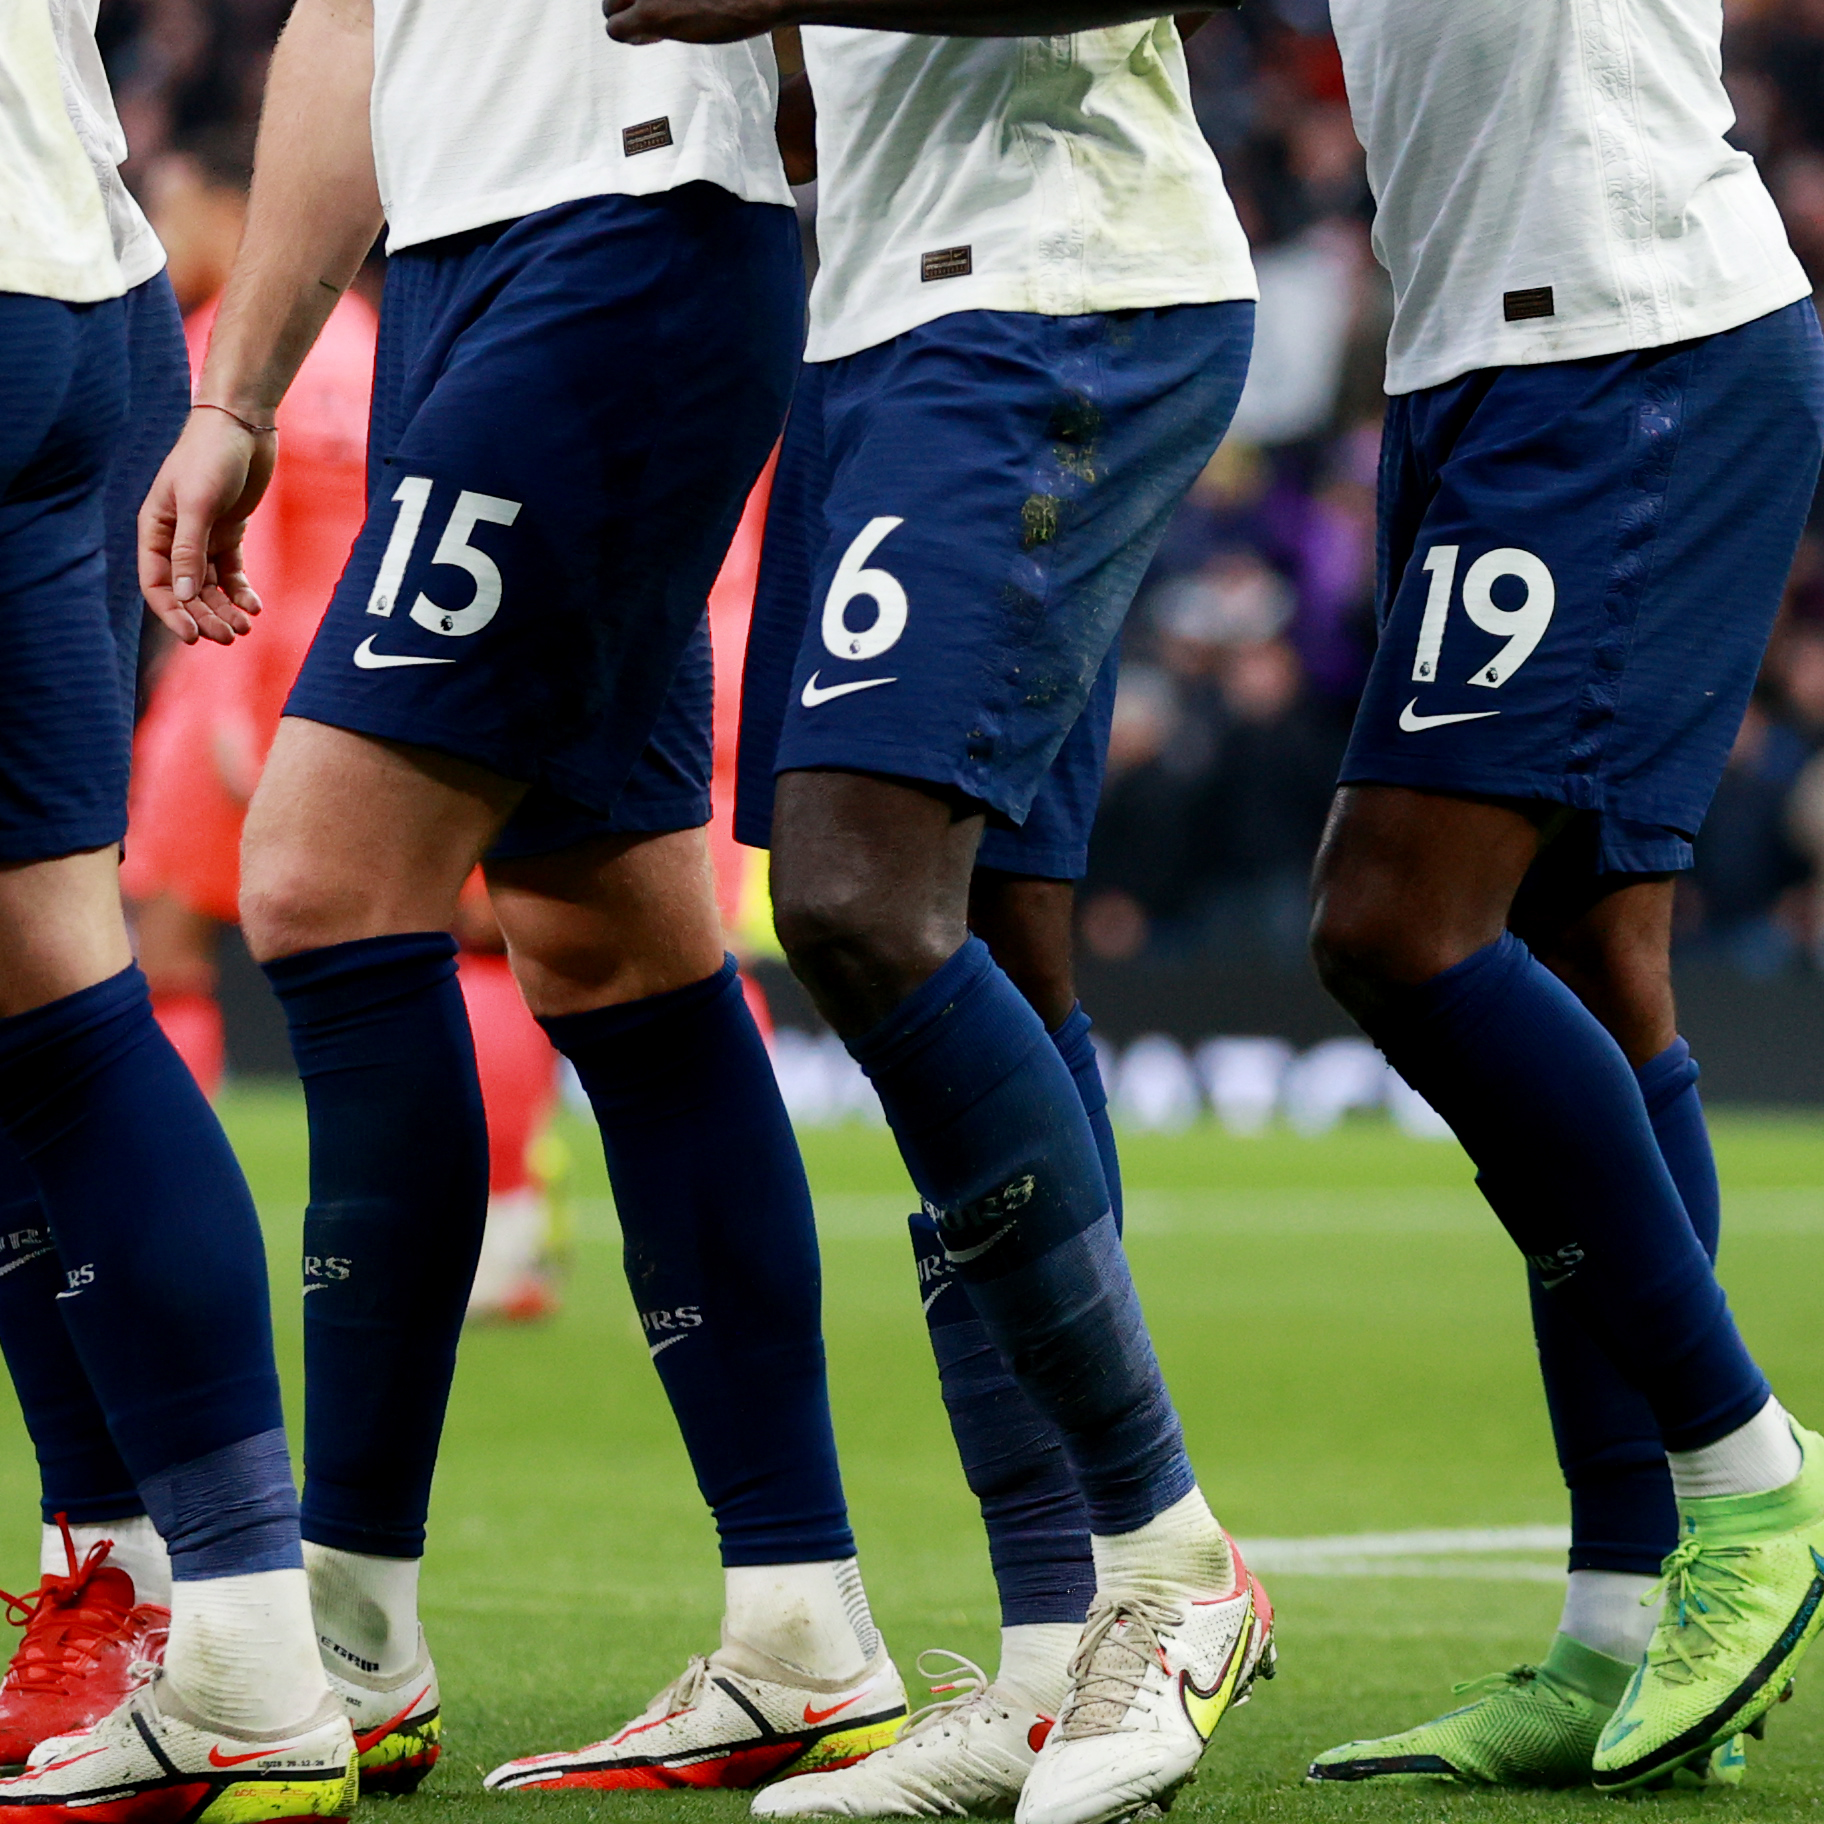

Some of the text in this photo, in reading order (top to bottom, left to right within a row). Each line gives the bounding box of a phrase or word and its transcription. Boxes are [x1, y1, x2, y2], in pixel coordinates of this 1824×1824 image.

[366, 475, 523, 638] 15
[821, 515, 909, 661] 6
[1411, 544, 1556, 689] 19
